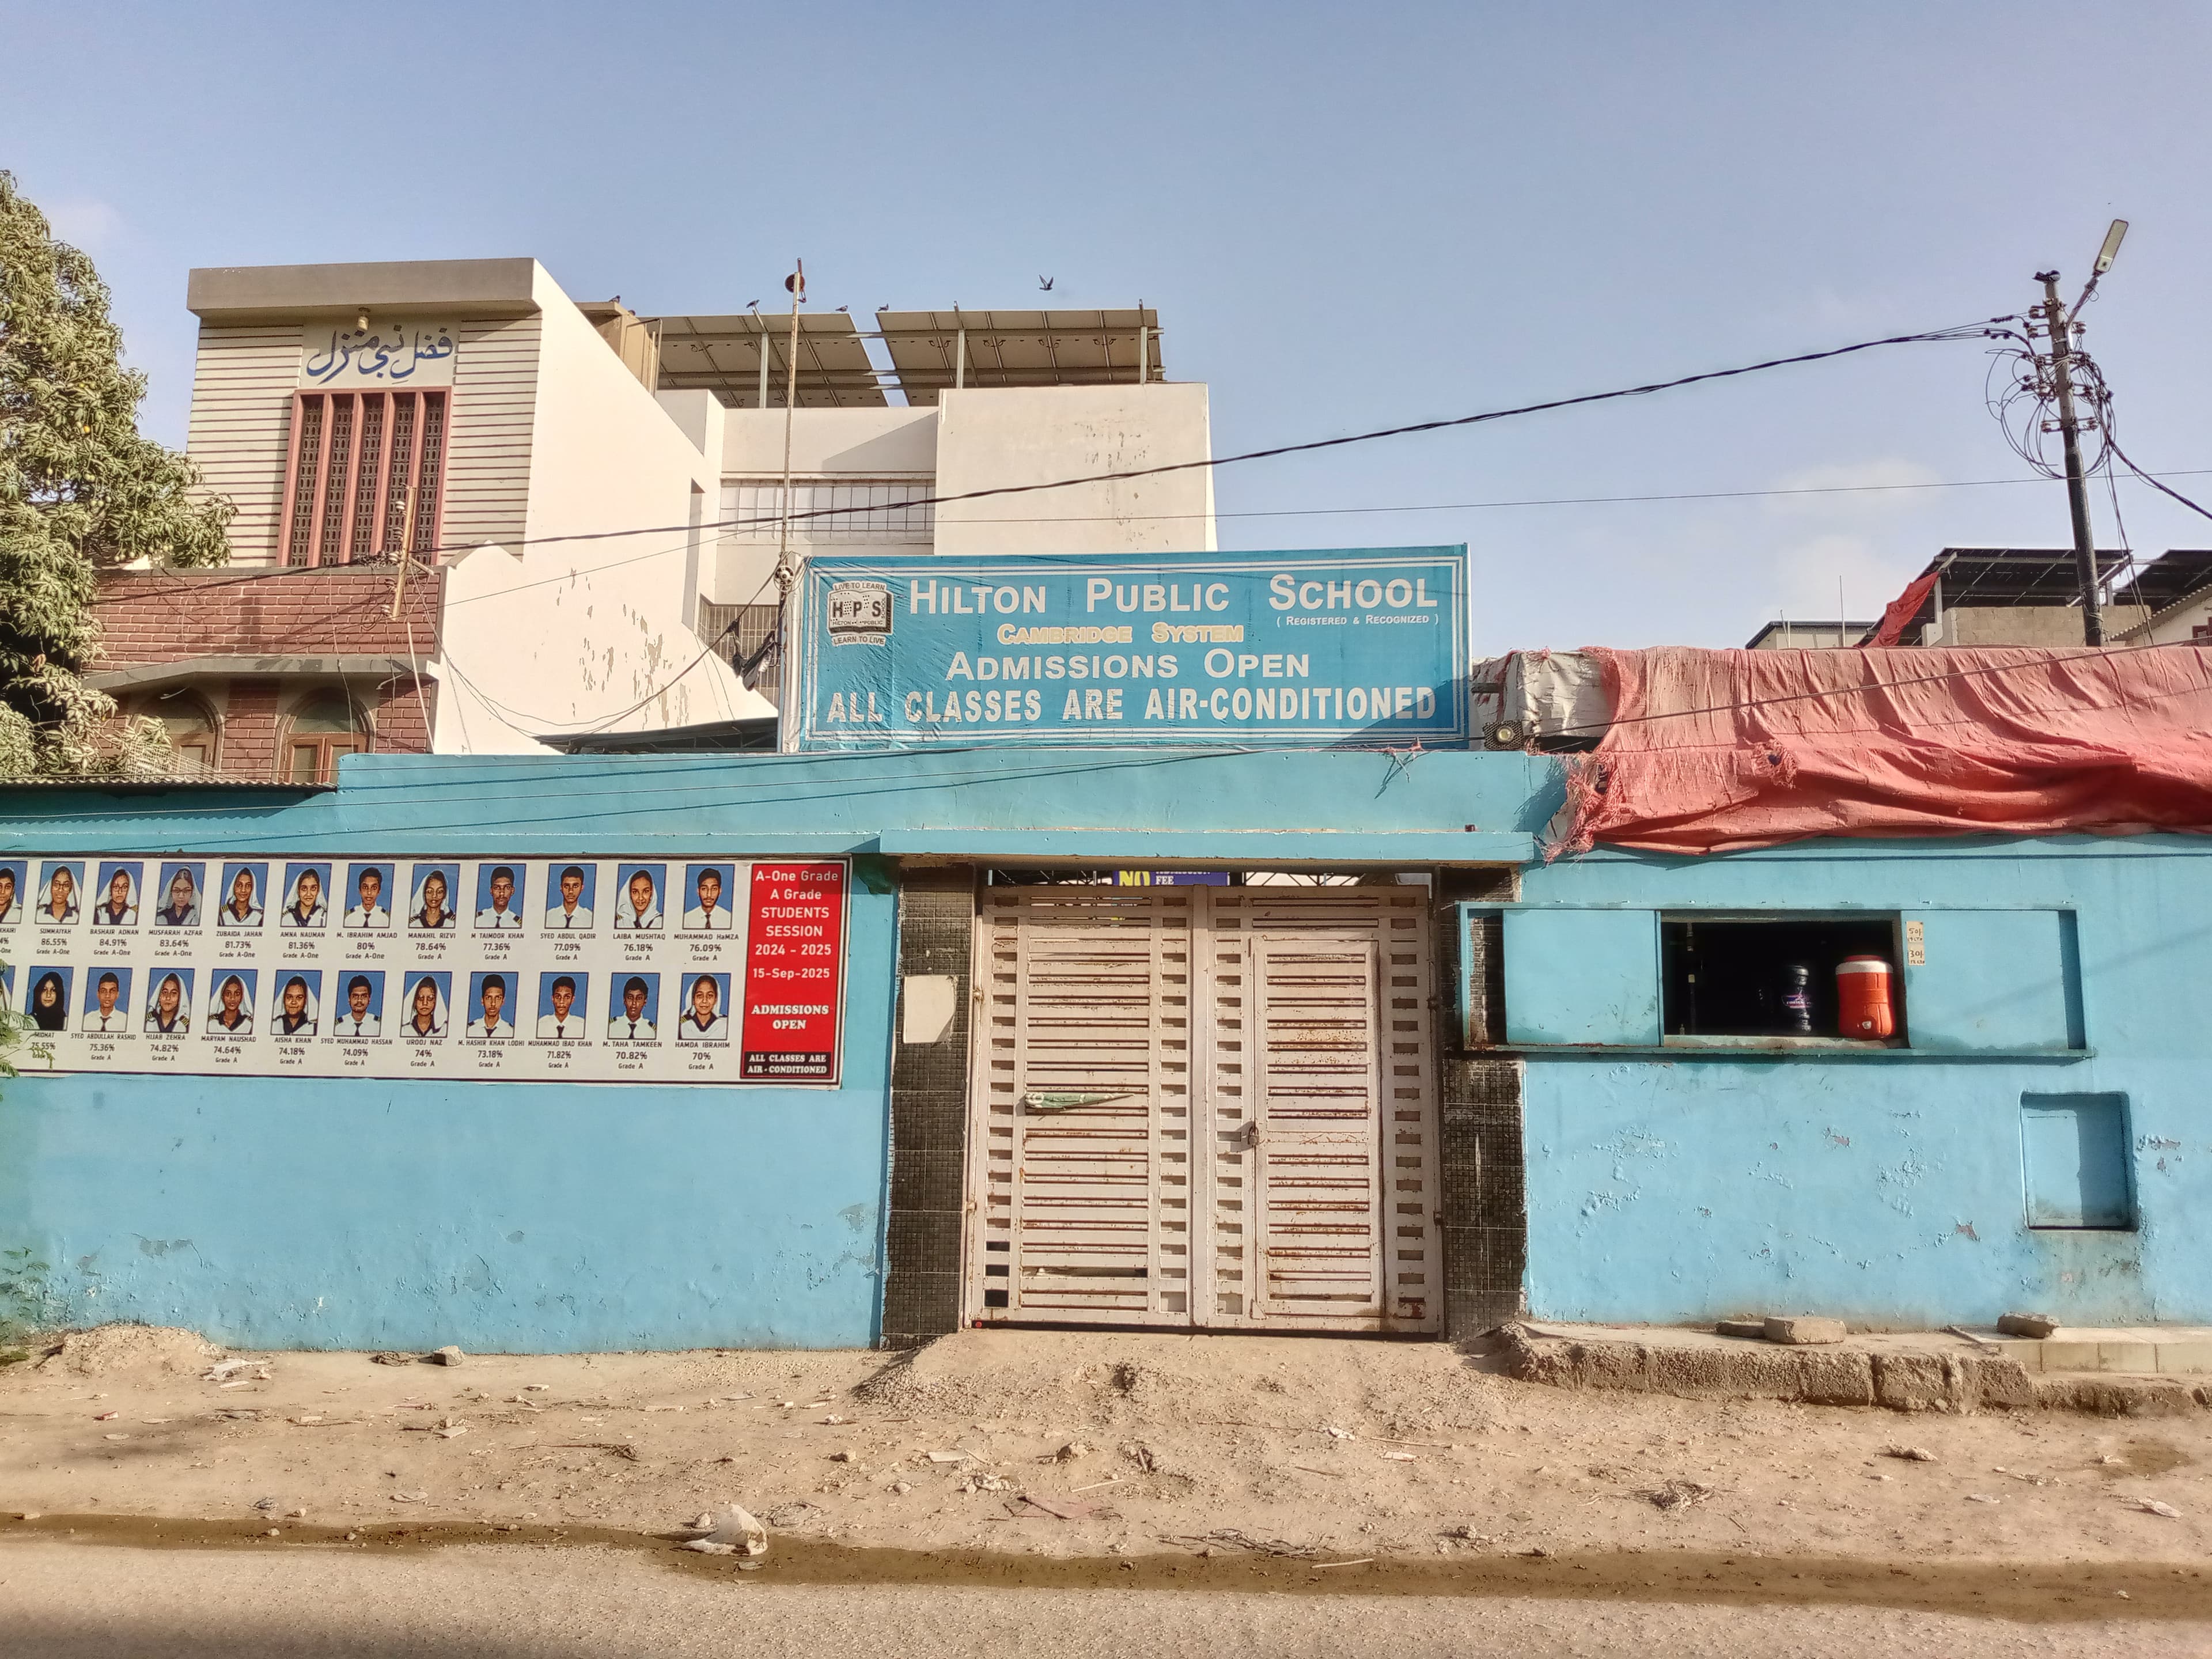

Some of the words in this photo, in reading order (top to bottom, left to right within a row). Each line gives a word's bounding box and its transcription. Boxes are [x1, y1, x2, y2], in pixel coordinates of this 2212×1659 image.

[835, 582, 849, 590] LIVE
[910, 579, 1046, 615] HILTON
[1087, 576, 1229, 612] PUBLIC
[1268, 574, 1438, 611] SCHOOL
[997, 623, 1132, 645] CAMBRIDGE
[1152, 622, 1244, 643] SYSTEM
[834, 637, 857, 645] LEARN
[945, 650, 1178, 681] ADMISSIONS
[1204, 647, 1309, 679] OPEN
[827, 691, 883, 723] ALL
[904, 690, 1041, 724] CLASSES
[1062, 688, 1123, 720] ARE
[1145, 687, 1436, 720] AIR-CONDITIONED
[755, 870, 796, 881] A-One
[801, 870, 838, 881] Grade
[1156, 875, 1175, 885] FEE
[770, 889, 779, 899] A
[785, 889, 821, 899] Grade
[761, 907, 829, 918] STUDENTS
[766, 926, 823, 937] SESSION
[755, 944, 785, 955] 2024
[801, 944, 831, 955] 2025
[753, 968, 830, 980] 15-Sep-2025
[752, 1005, 829, 1014] ADMISSIONS
[772, 1020, 806, 1029] OPEN
[343, 1048, 368, 1056] 74.09%
[478, 1050, 503, 1058] 73.18%
[547, 1051, 571, 1059] 71.82%
